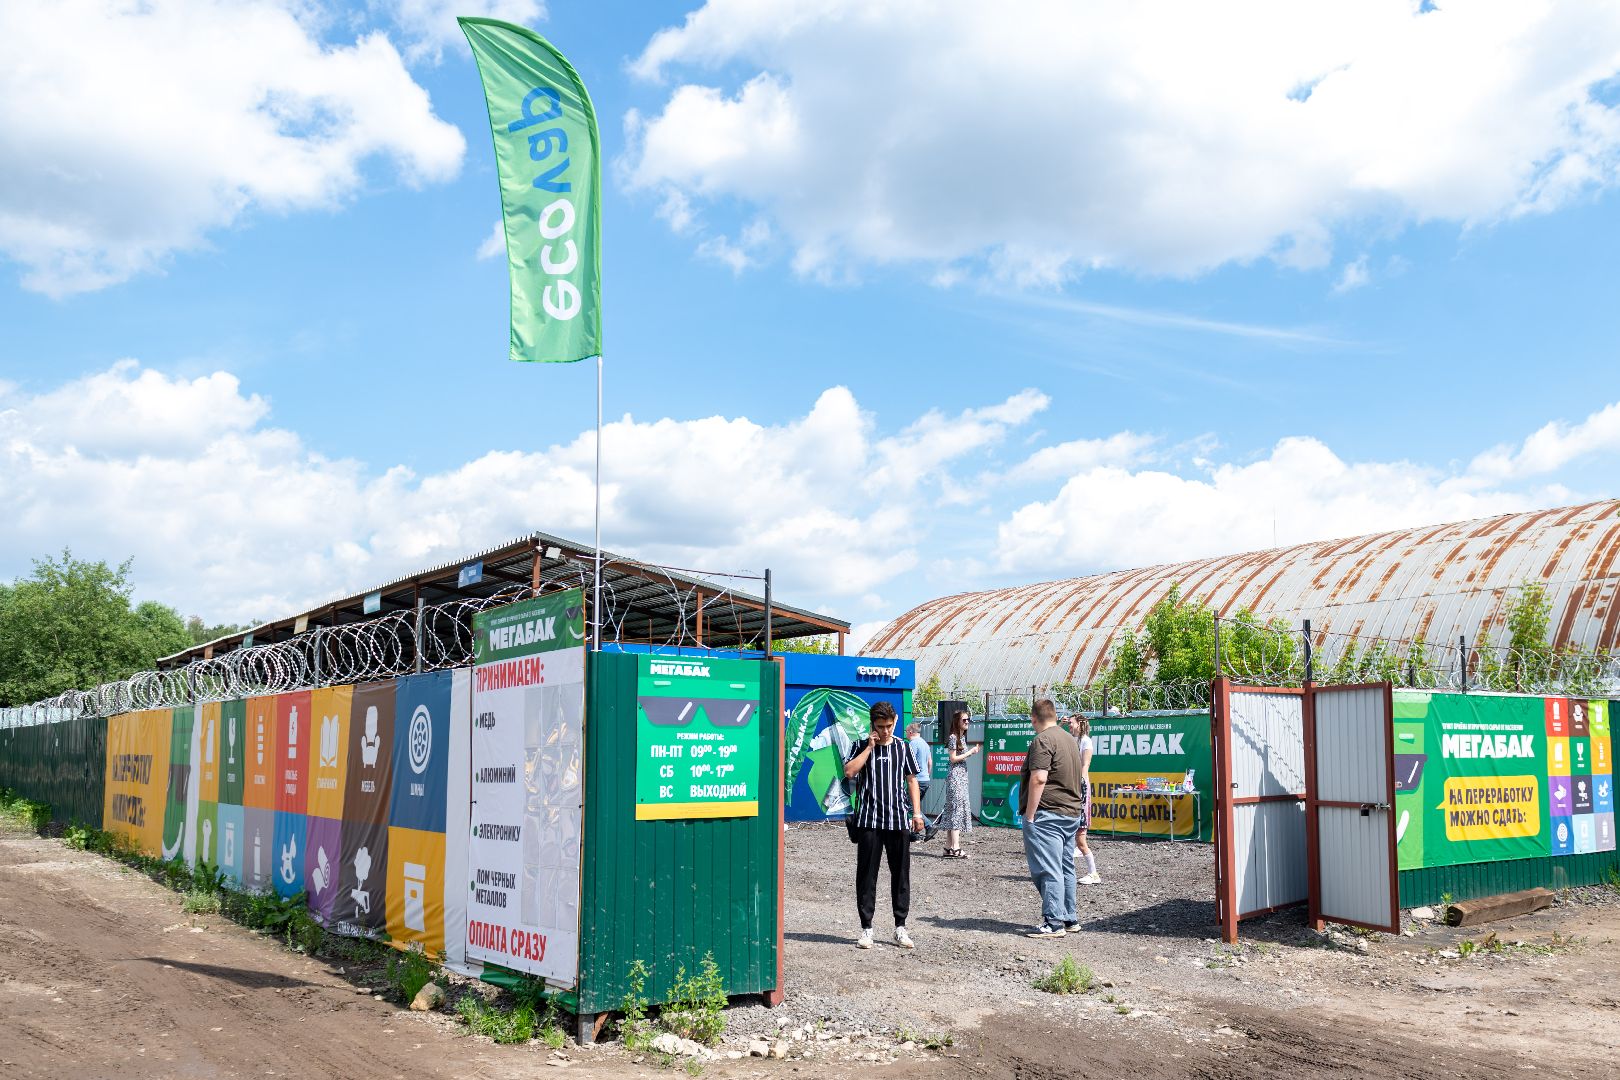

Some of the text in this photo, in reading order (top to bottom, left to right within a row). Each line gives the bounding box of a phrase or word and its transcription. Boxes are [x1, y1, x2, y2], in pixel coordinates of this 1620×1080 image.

[489, 616, 556, 651] МЕГАБАК
[477, 657, 544, 693] ПРИНИМАЕМ:
[650, 664, 711, 677] МЕГАБАК
[857, 666, 900, 679] ecovap
[479, 712, 496, 730] МЕДЬ
[677, 732, 725, 741] РЕЖИМ РАБОТЫ:
[651, 745, 683, 758] ПН-ПТ
[1442, 734, 1535, 758] МЕГАБАК
[480, 764, 516, 783] АЛЮМИНИЙ
[660, 765, 674, 778] СБ
[660, 782, 747, 799] ВС ВЫХОДНОЙ
[1449, 787, 1533, 805] НА ПЕРЕРАБОТКУ
[1091, 803, 1127, 819] ОЖНО
[1450, 808, 1526, 827] МОЖНО СДАТЬ:
[478, 823, 521, 842] ЭЛЕКТРОНИКУ
[476, 868, 516, 890] ЛОМ ЧЕРНЫХ
[475, 888, 507, 908] МЕТАЛЛОВ
[469, 920, 547, 962] ОПЛАТА СРАЗУ
